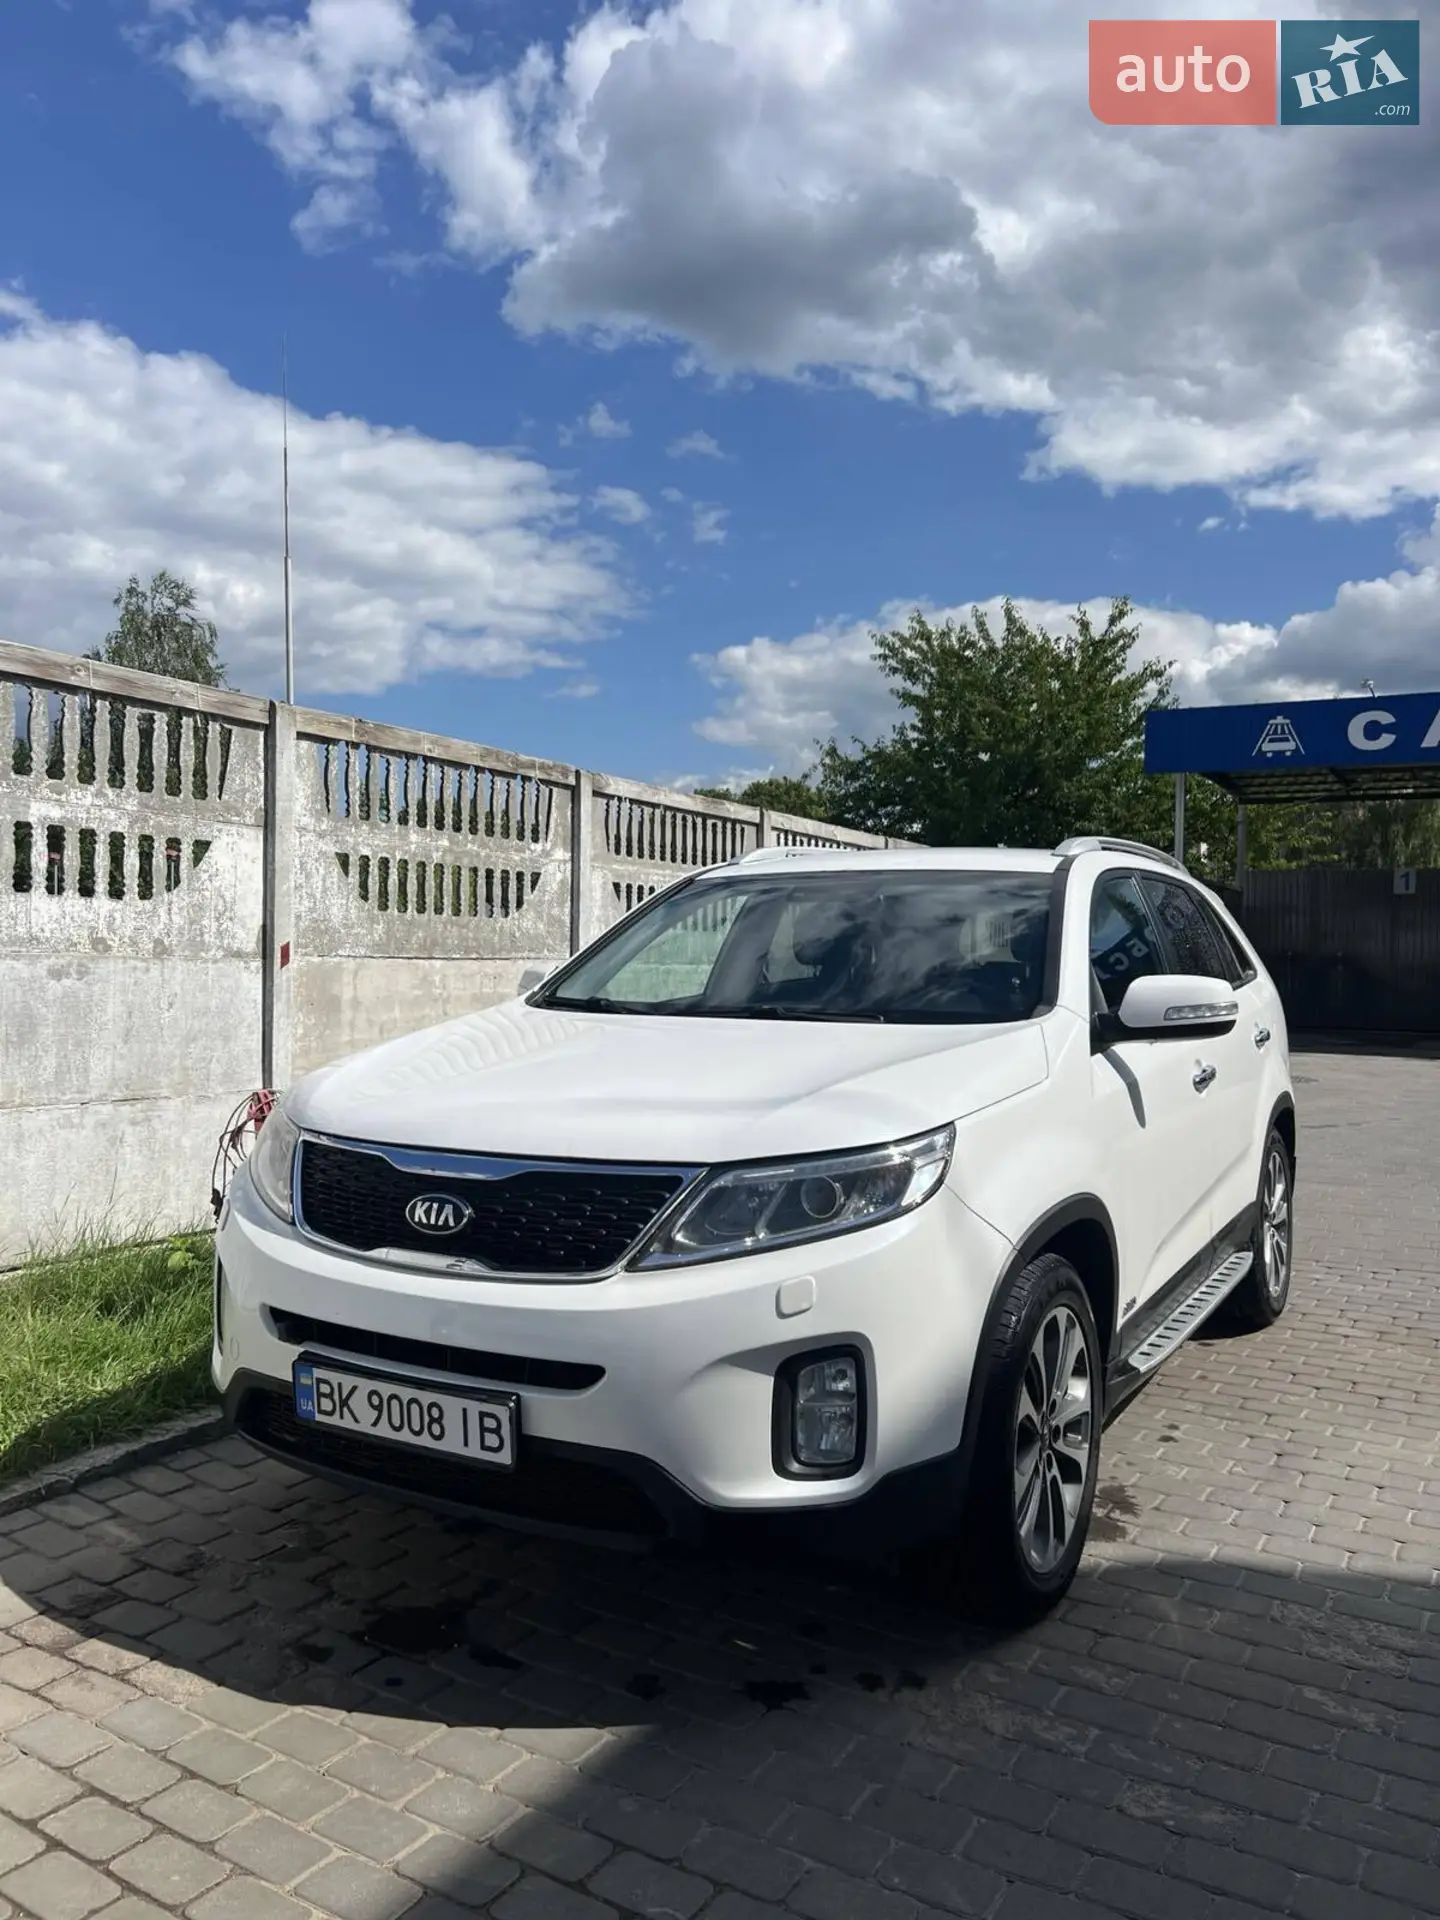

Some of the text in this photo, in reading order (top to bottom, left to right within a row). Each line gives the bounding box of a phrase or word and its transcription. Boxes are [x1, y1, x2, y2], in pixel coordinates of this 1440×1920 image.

[1400, 871, 1411, 892] 1
[414, 1200, 455, 1227] KIA
[300, 1398, 314, 1412] UA
[315, 1377, 505, 1454] BK 9008 IB
